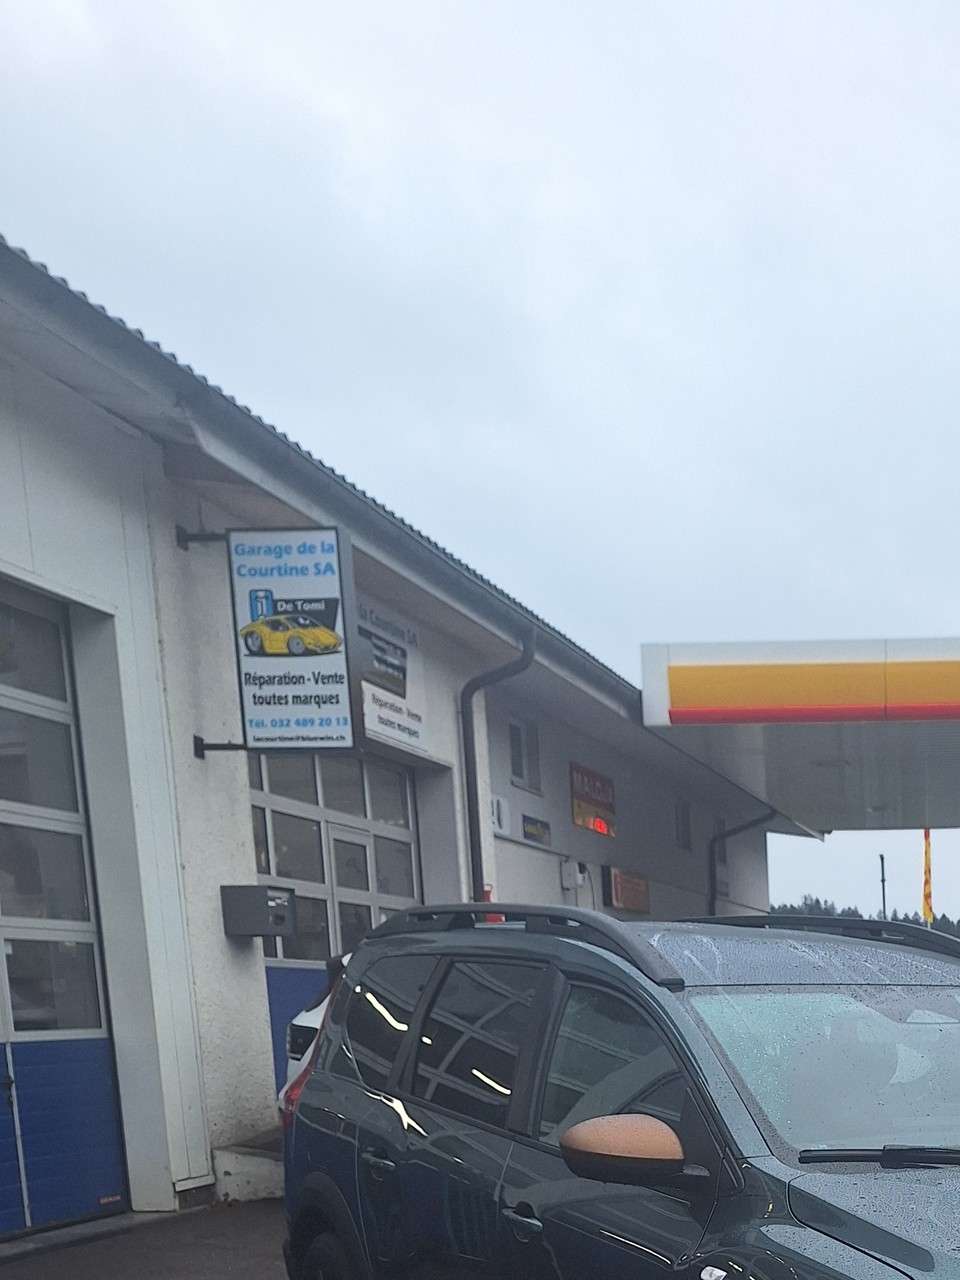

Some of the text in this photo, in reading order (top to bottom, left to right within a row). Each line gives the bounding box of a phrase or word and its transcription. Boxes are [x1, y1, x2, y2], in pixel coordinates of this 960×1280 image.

[234, 541, 335, 559] Garage de la
[236, 561, 336, 577] Courtine SA
[277, 600, 325, 611] De Tomi
[244, 671, 306, 689] Réparation
[312, 671, 345, 685] Vente
[252, 693, 340, 709] toutes marques
[270, 718, 291, 728] 032
[318, 717, 332, 727] 20
